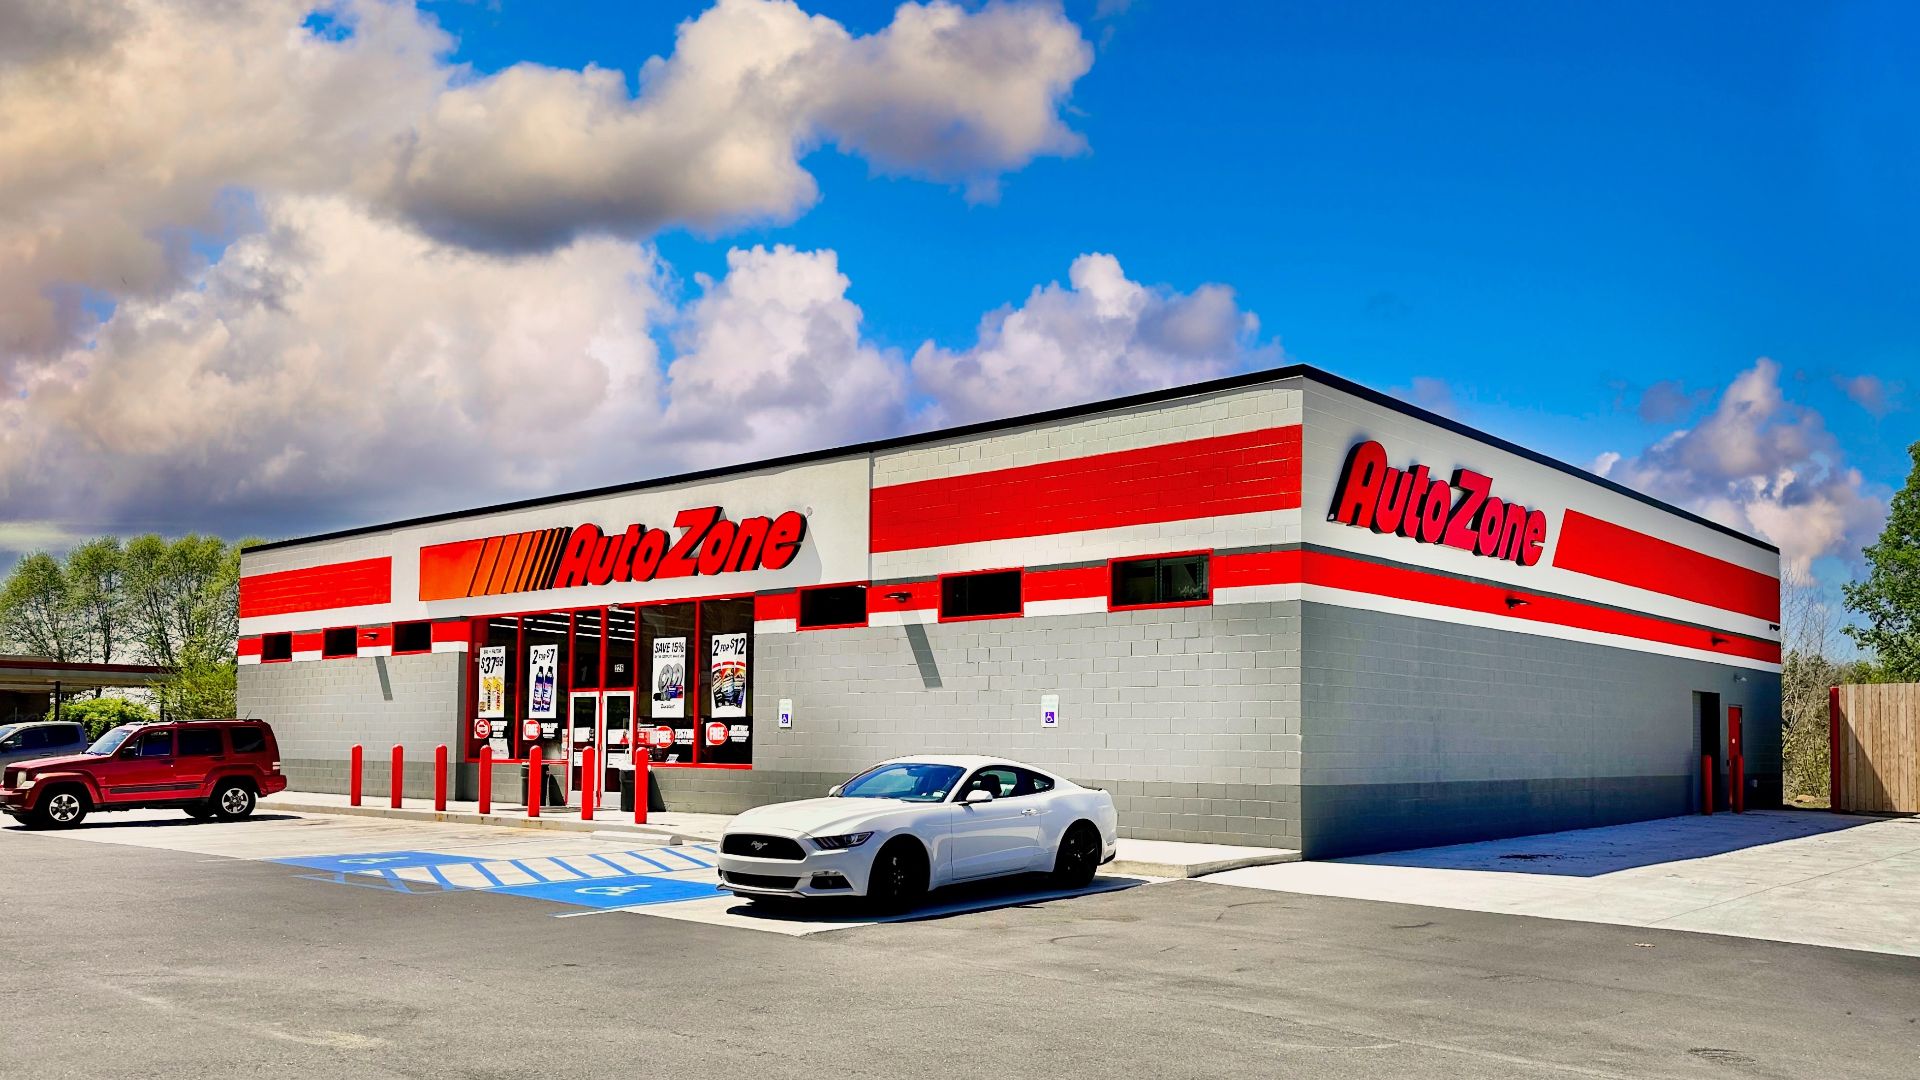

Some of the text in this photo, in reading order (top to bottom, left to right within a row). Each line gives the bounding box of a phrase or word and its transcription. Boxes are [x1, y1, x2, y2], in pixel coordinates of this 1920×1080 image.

[1328, 440, 1547, 566] AutoZone
[553, 506, 806, 588] AutoZone
[655, 641, 685, 654] SAVE 15%
[713, 640, 720, 656] 2
[730, 637, 746, 655] $12
[532, 649, 539, 665] 2
[546, 648, 555, 663] $7
[526, 723, 540, 737] FREE
[657, 730, 672, 743] FREE
[710, 726, 725, 741] FREE
